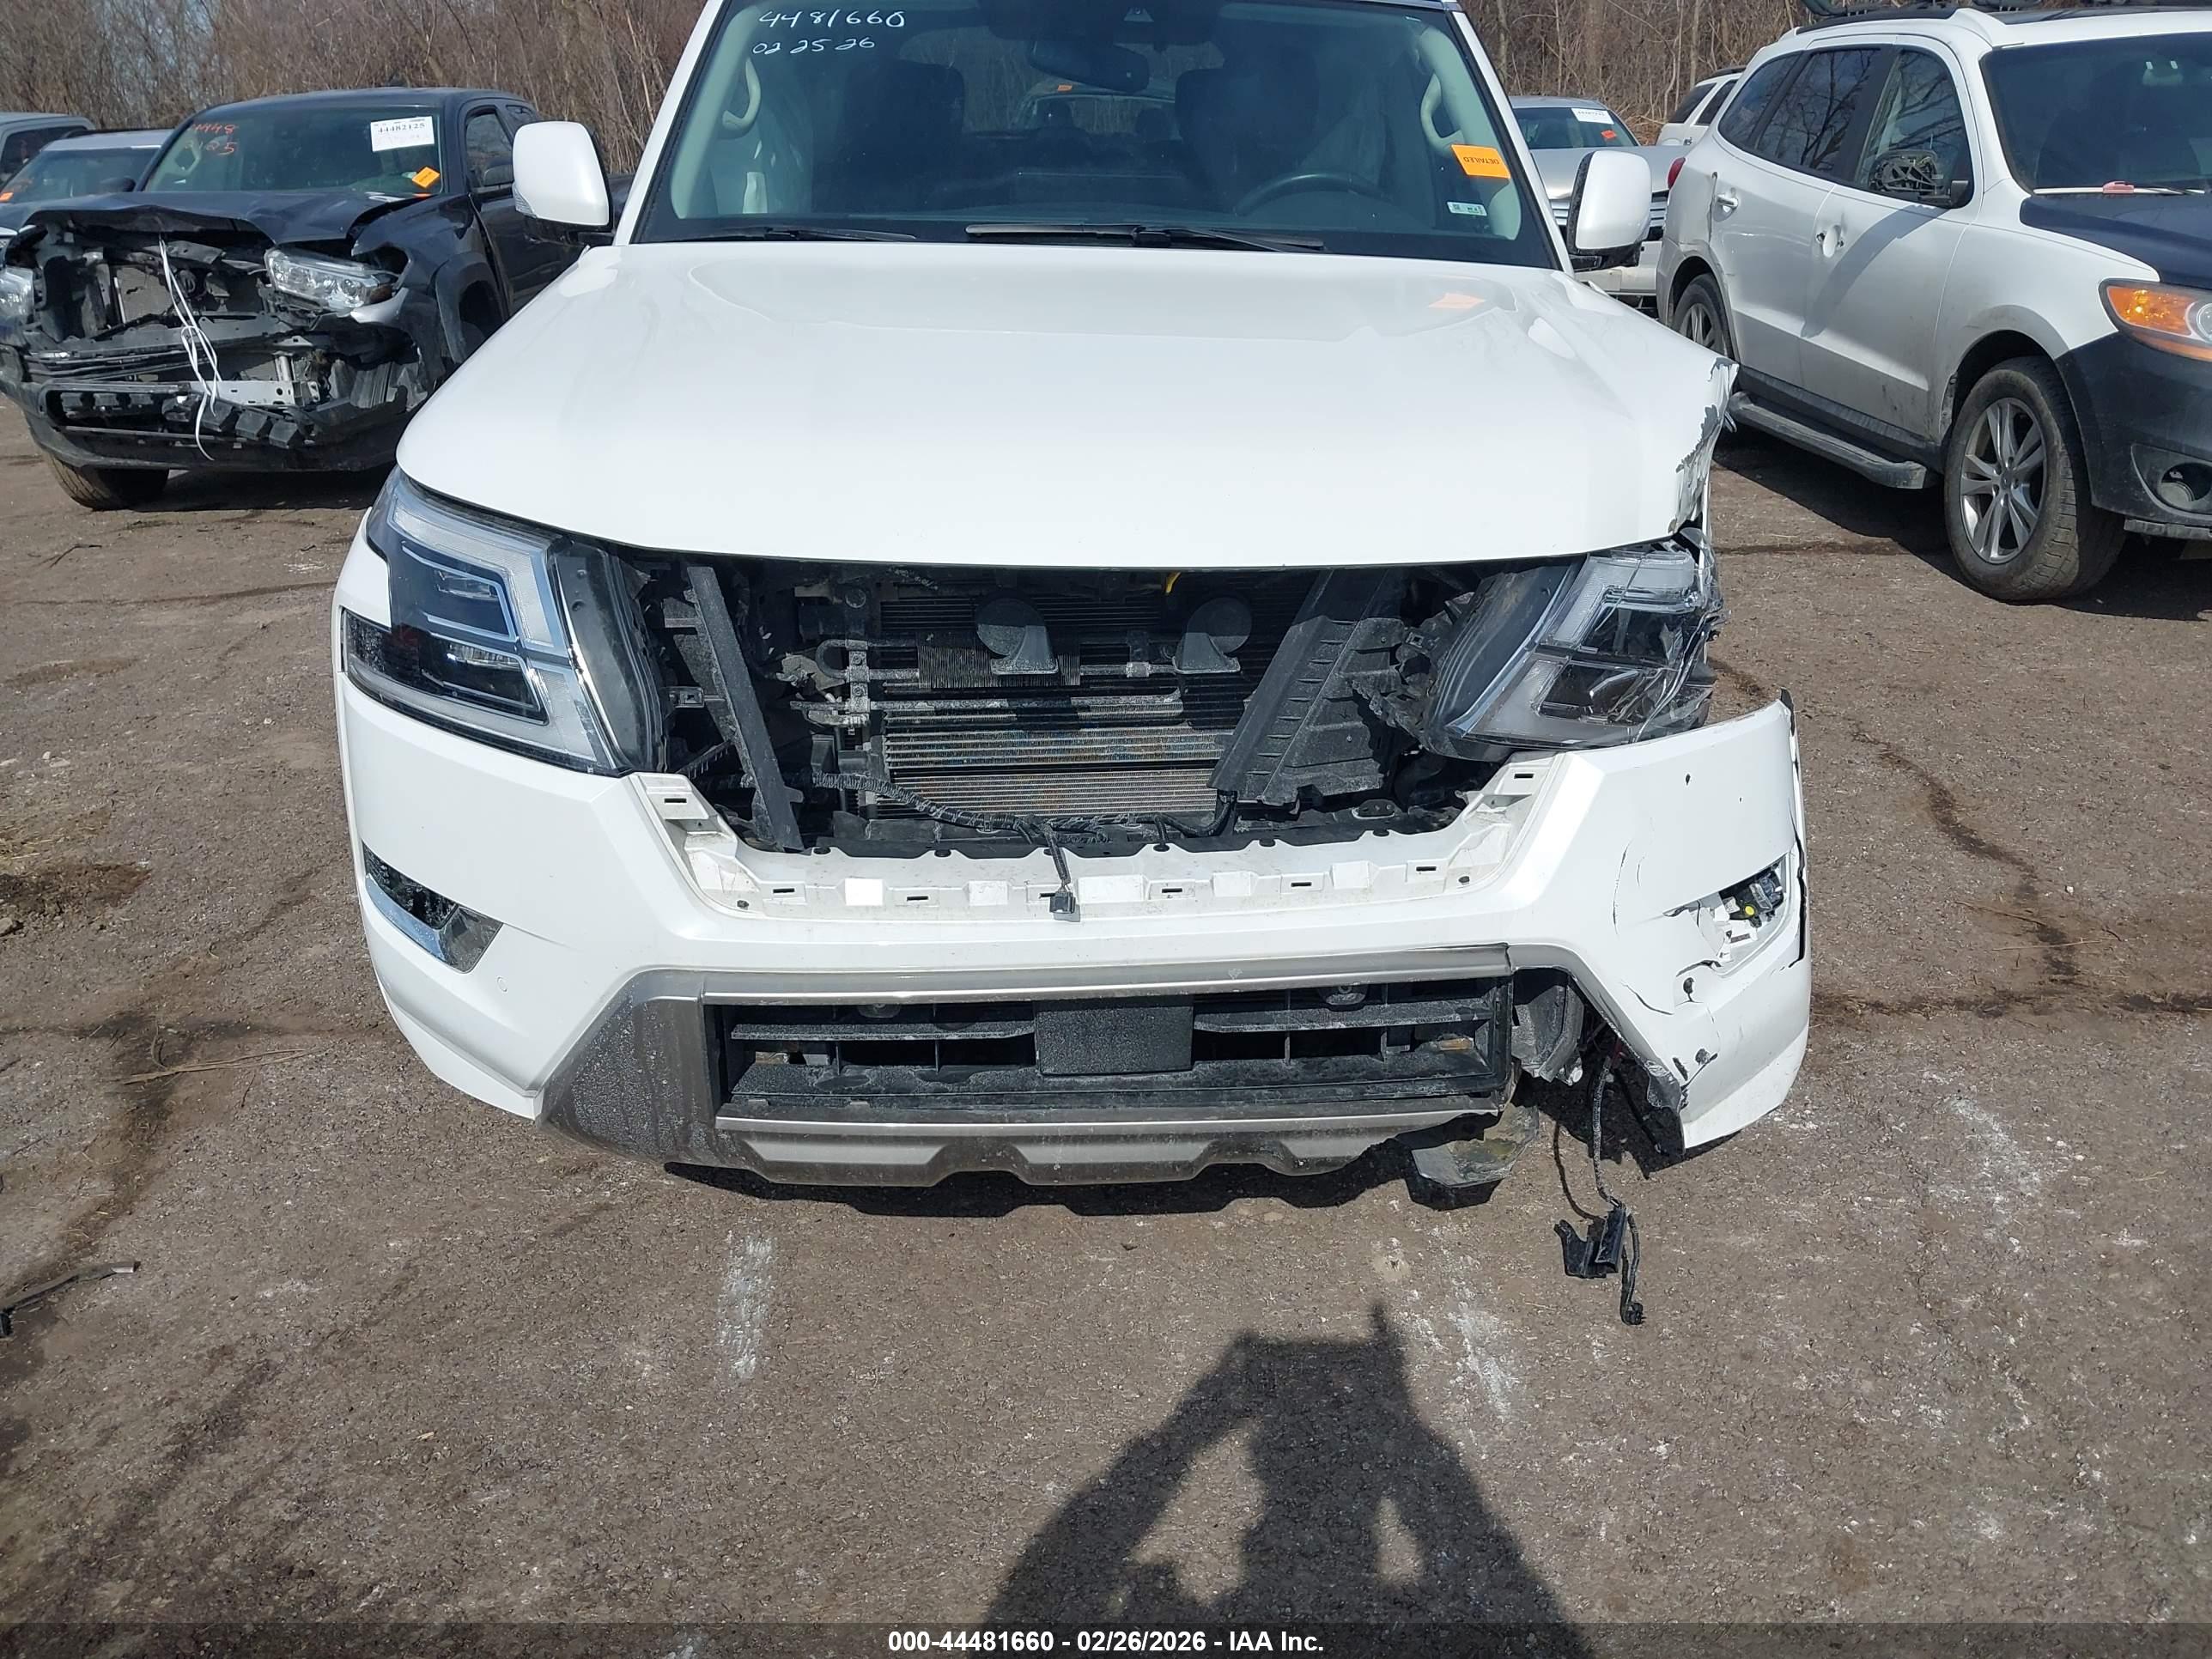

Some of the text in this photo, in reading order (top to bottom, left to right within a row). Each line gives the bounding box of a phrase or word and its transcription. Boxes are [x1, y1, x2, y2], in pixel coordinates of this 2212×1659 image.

[759, 9, 906, 28] 4481660
[752, 37, 875, 55] 02 25 26
[1463, 156, 1501, 165] DETAILED
